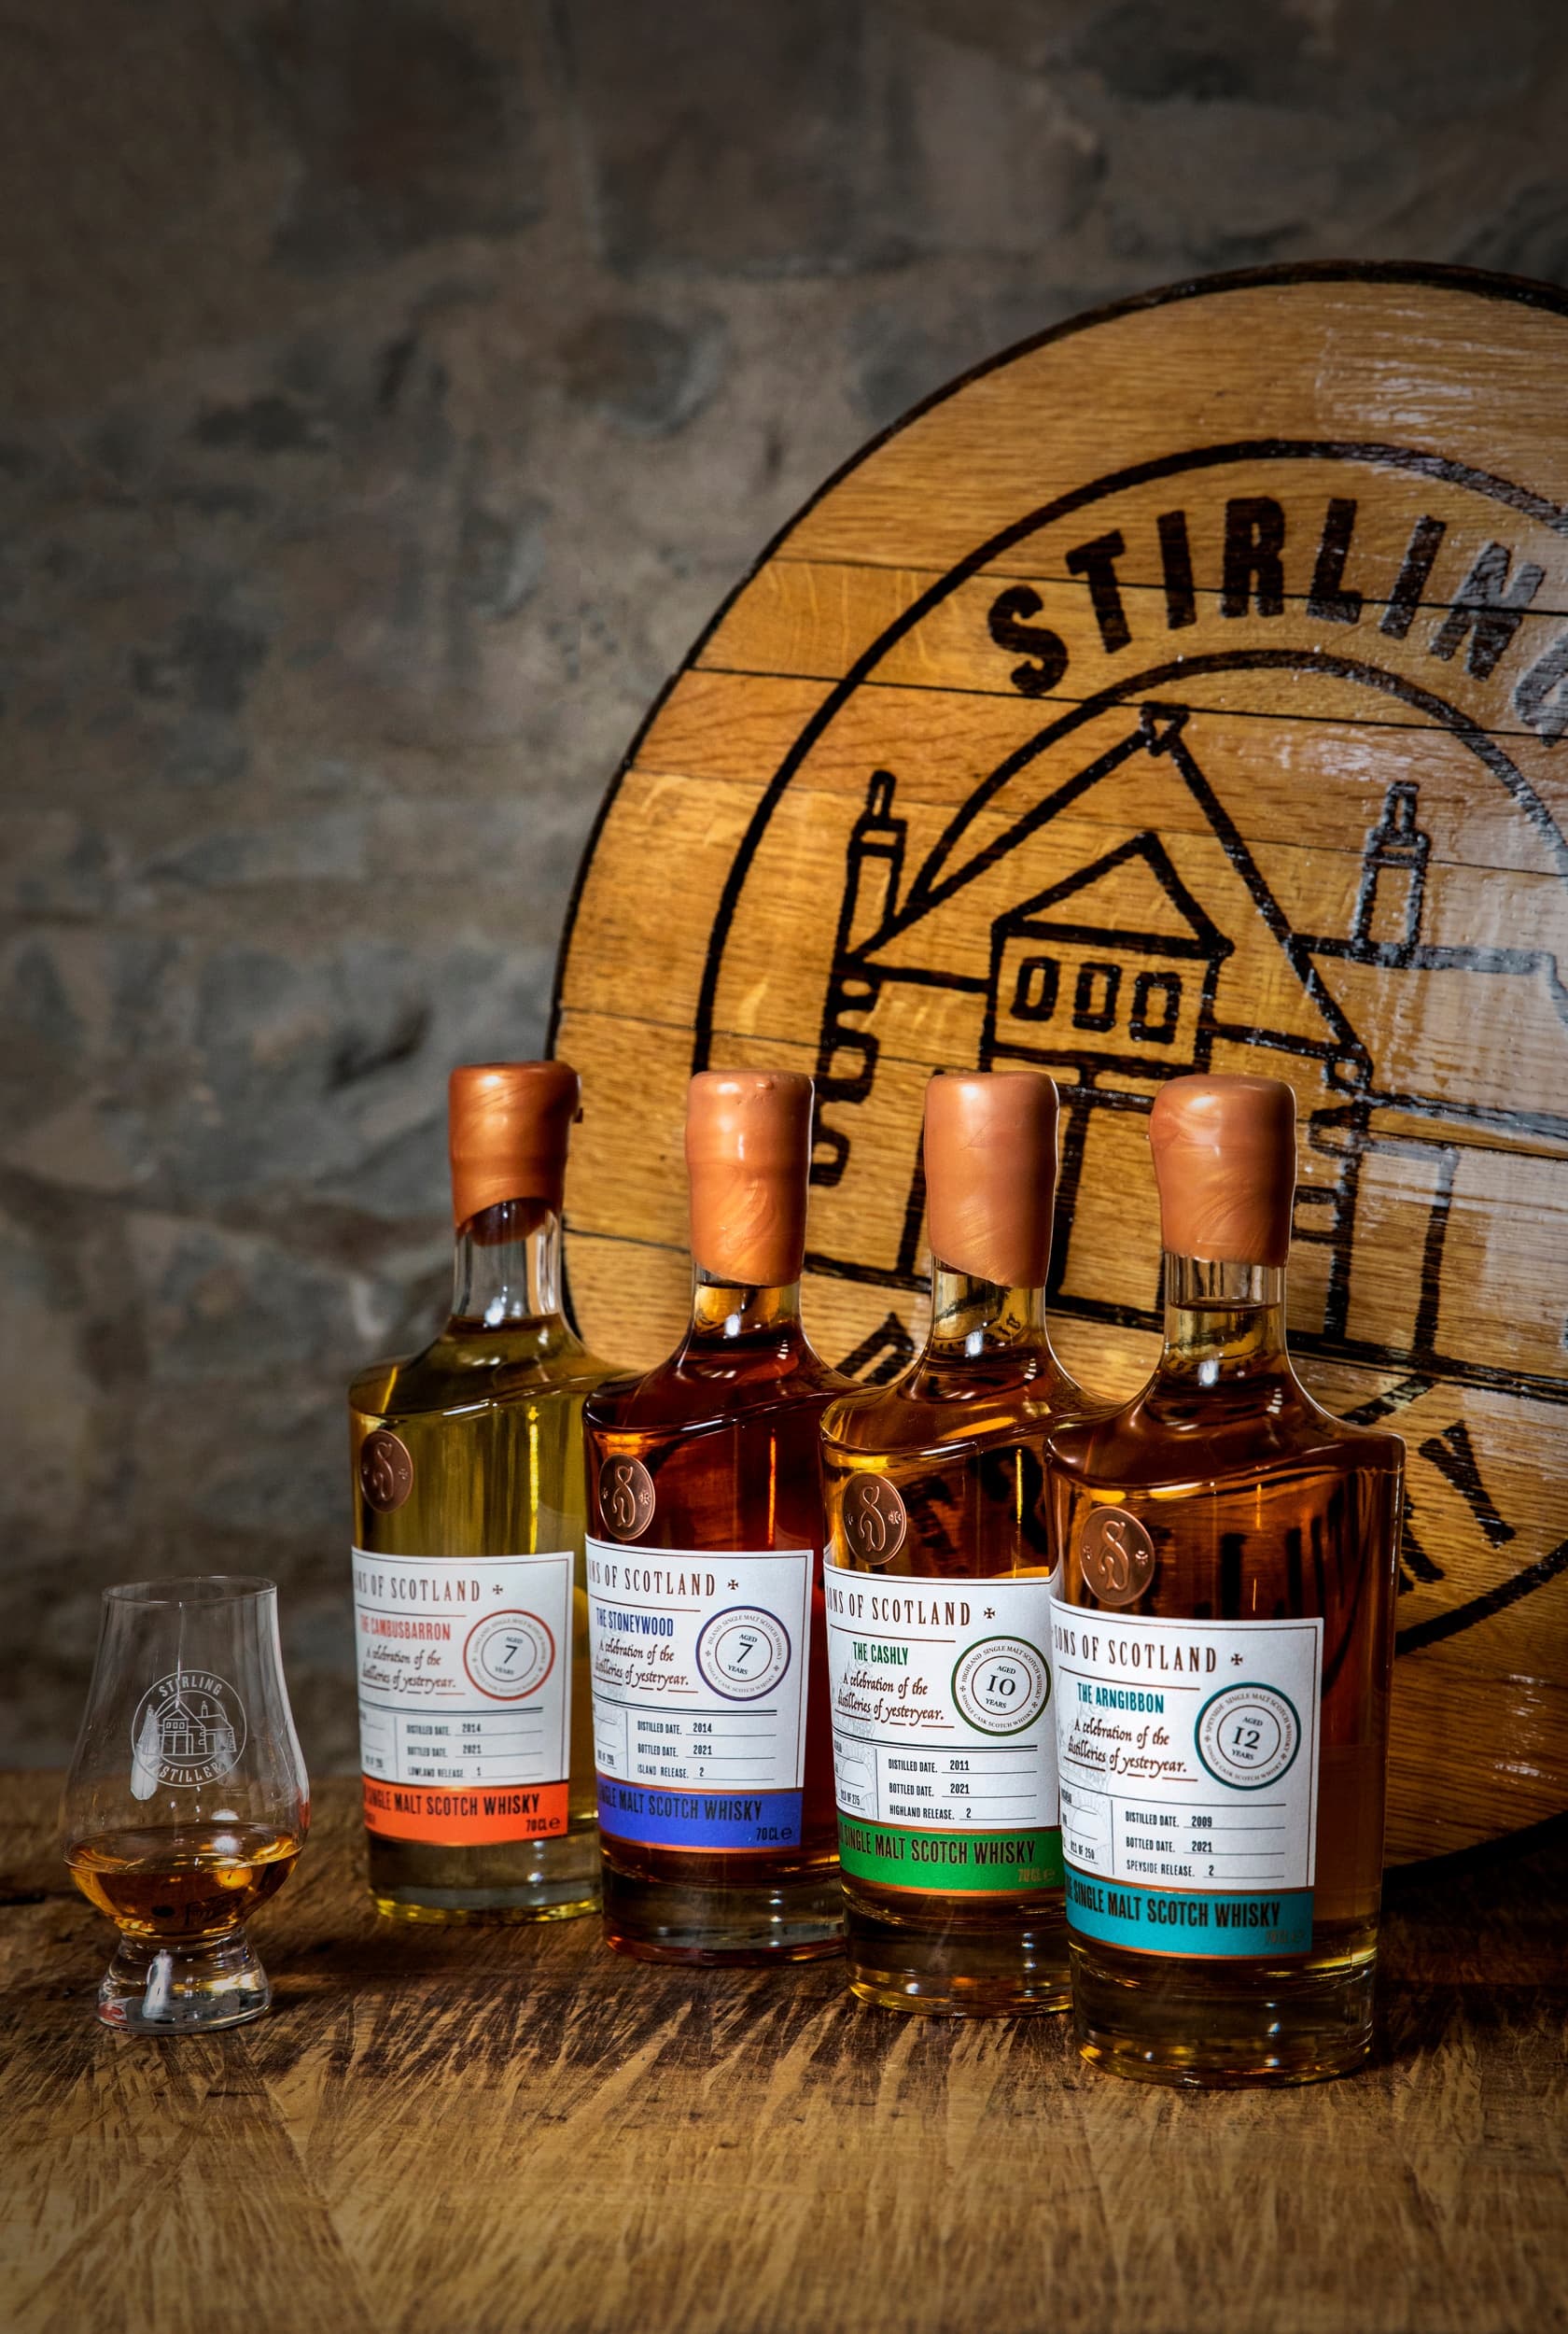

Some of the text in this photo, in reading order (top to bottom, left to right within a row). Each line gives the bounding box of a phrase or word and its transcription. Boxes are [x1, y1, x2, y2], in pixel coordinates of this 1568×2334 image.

[371, 1574, 384, 1597] OF
[390, 1577, 481, 1602] SCOTLAND
[605, 1564, 618, 1588] OF
[624, 1568, 715, 1596] SCOTLAND
[849, 1593, 864, 1618] OF
[872, 1596, 971, 1626] SCOTLAND
[371, 1616, 451, 1641] CAMBUSBARRON
[596, 1607, 674, 1638] THE STONEYWOOD
[707, 1624, 722, 1645] ISLAND
[722, 1614, 742, 1625] SINGLE
[760, 1618, 777, 1638] SCOTCH
[739, 1634, 758, 1643] AGED
[414, 1649, 426, 1670] of
[427, 1649, 441, 1666] the
[504, 1644, 519, 1664] 7
[606, 1638, 644, 1658] celebration
[648, 1644, 658, 1666] of
[660, 1645, 675, 1662] the
[738, 1642, 753, 1664] 7
[852, 1641, 909, 1666] THE CASHLY
[1082, 1634, 1099, 1662] OF
[1109, 1639, 1217, 1673] SCOTLAND
[392, 1668, 402, 1690] of
[398, 1676, 456, 1695] yesteryear.
[625, 1664, 635, 1685] of
[631, 1670, 690, 1691] yesteryear.
[728, 1665, 749, 1676] YEARS
[961, 1646, 1043, 1699] HIGHLAND SINGLE MALT SCOTCH WHISKY
[997, 1665, 1016, 1675] AGED
[159, 1675, 223, 1697] STIRLING
[843, 1670, 929, 1699] A celebration of the
[986, 1674, 1016, 1696] 10
[838, 1688, 945, 1726] distilleries of yesteryear.
[962, 1694, 974, 1715] SINGLE
[973, 1713, 987, 1724] CASK
[1012, 1709, 1034, 1726] WHISKY
[986, 1698, 1007, 1708] YEARS
[1077, 1682, 1165, 1714] THE ARNGIBBON
[637, 1720, 664, 1734] DISTILLED
[693, 1722, 712, 1734] 2014
[1074, 1717, 1170, 1750] A celebration of the
[1206, 1693, 1293, 1751] SPEYSIDE SINGLE MALT SCOTCH WHISKY
[1242, 1716, 1263, 1726] AGED
[637, 1743, 661, 1755] BOTTLED
[693, 1744, 712, 1755] 2021
[1232, 1725, 1261, 1750] 12
[888, 1758, 970, 1773] DISTILLED DATE. 2011
[1068, 1735, 1187, 1779] distilleries of yesteryear.
[1231, 1749, 1254, 1760] YEARS
[637, 1764, 705, 1779] ISLAND RELEASE. 2
[1219, 1765, 1235, 1777] CASK
[1260, 1762, 1282, 1779] WHISKY
[889, 1782, 970, 1797] BOTTLED DATE. 2021
[394, 1792, 423, 1815] MALT
[427, 1795, 478, 1817] SCOTCH
[483, 1793, 540, 1816] WHISKY
[619, 1793, 644, 1814] MALT
[649, 1795, 699, 1820] SCOTCH
[704, 1799, 762, 1821] WHISKY
[889, 1804, 972, 1821] HIGHLAND RELEASE. 2
[1125, 1810, 1212, 1828] DISTILLED DATE. 2009
[844, 1826, 872, 1855] SINGLE
[875, 1835, 905, 1860] MALT
[911, 1839, 968, 1864] SCOTCH
[973, 1840, 1035, 1865] WHISKY
[1085, 1845, 1095, 1860] 250
[1126, 1836, 1212, 1853] BOTTLED DATE. 2021
[1127, 1859, 1214, 1877] SPEYSIDE RELEASE. 2
[1074, 1880, 1103, 1913] SINGLE
[1108, 1891, 1142, 1921] MALT
[1147, 1899, 1209, 1927] SCOTCH
[1214, 1902, 1281, 1929] WHISKY
